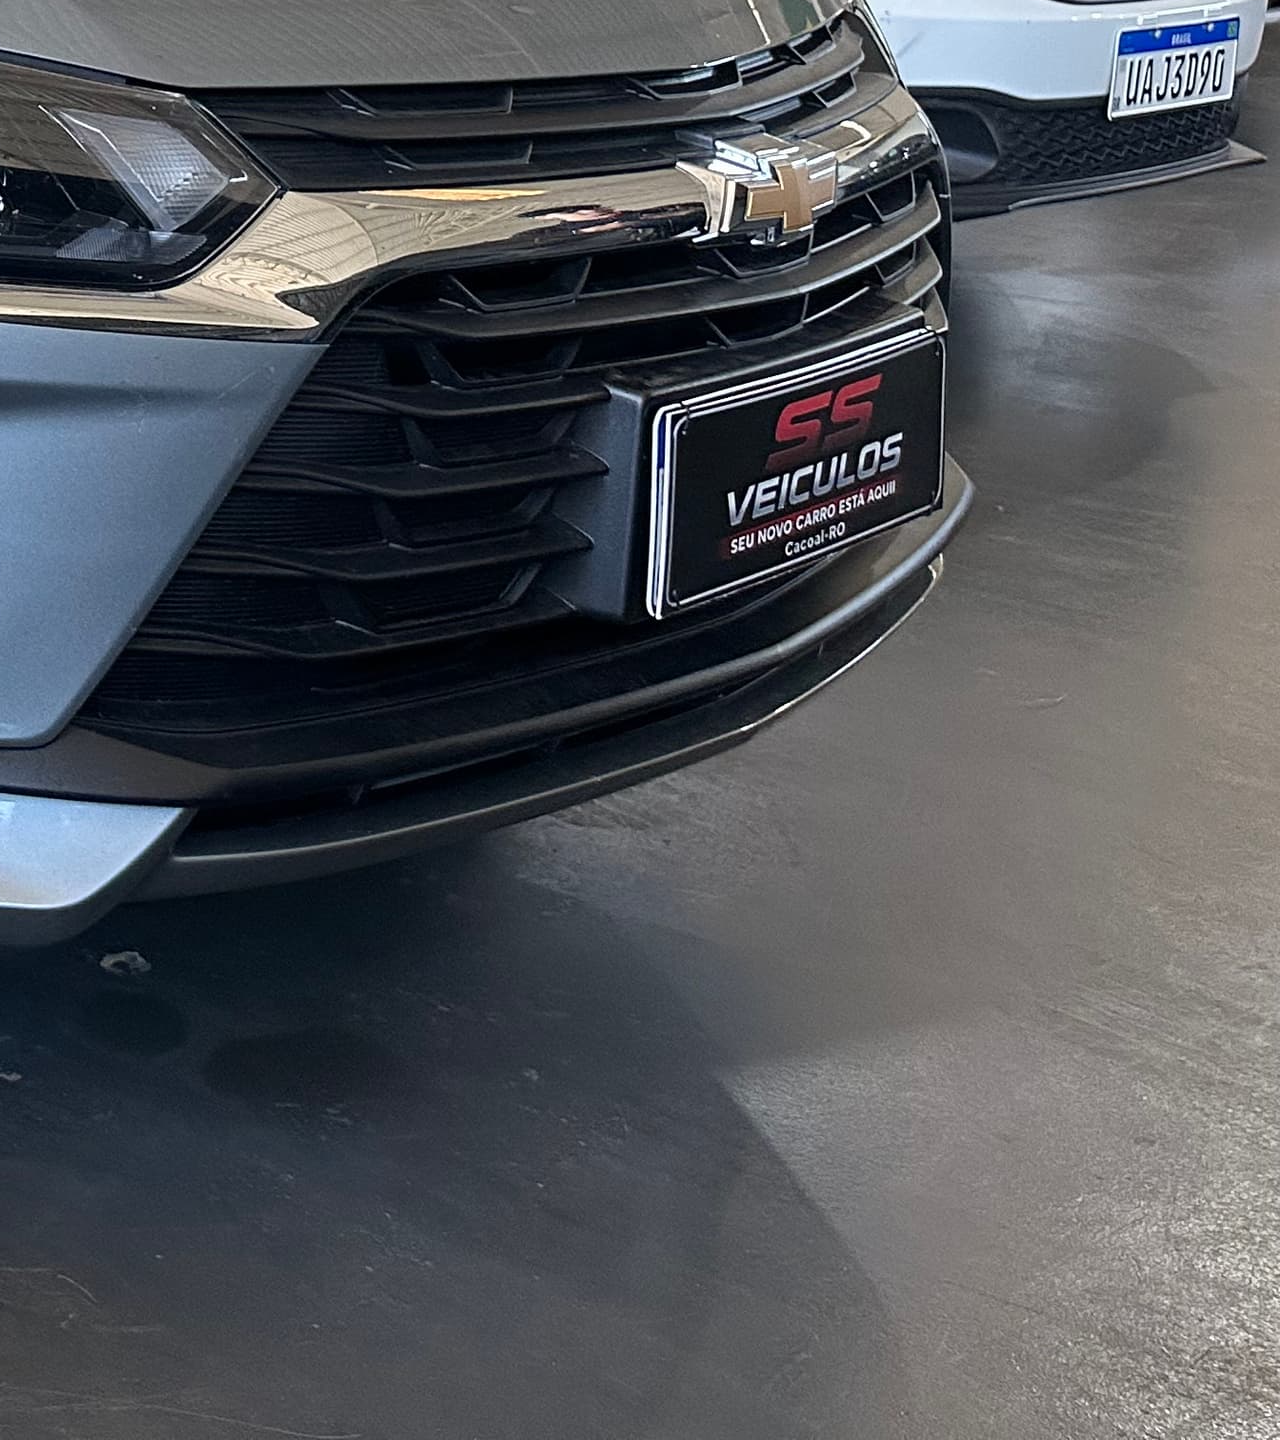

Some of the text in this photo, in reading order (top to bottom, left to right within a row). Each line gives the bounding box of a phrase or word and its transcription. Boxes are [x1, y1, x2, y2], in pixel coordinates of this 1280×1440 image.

[765, 373, 882, 471] SS
[727, 432, 903, 527] VEICULOS
[730, 533, 755, 555] SEU
[757, 520, 792, 545] NOVO
[795, 504, 836, 531] CARRO
[839, 488, 865, 514] ESTÁ
[785, 522, 845, 556] Cacoal-RO
